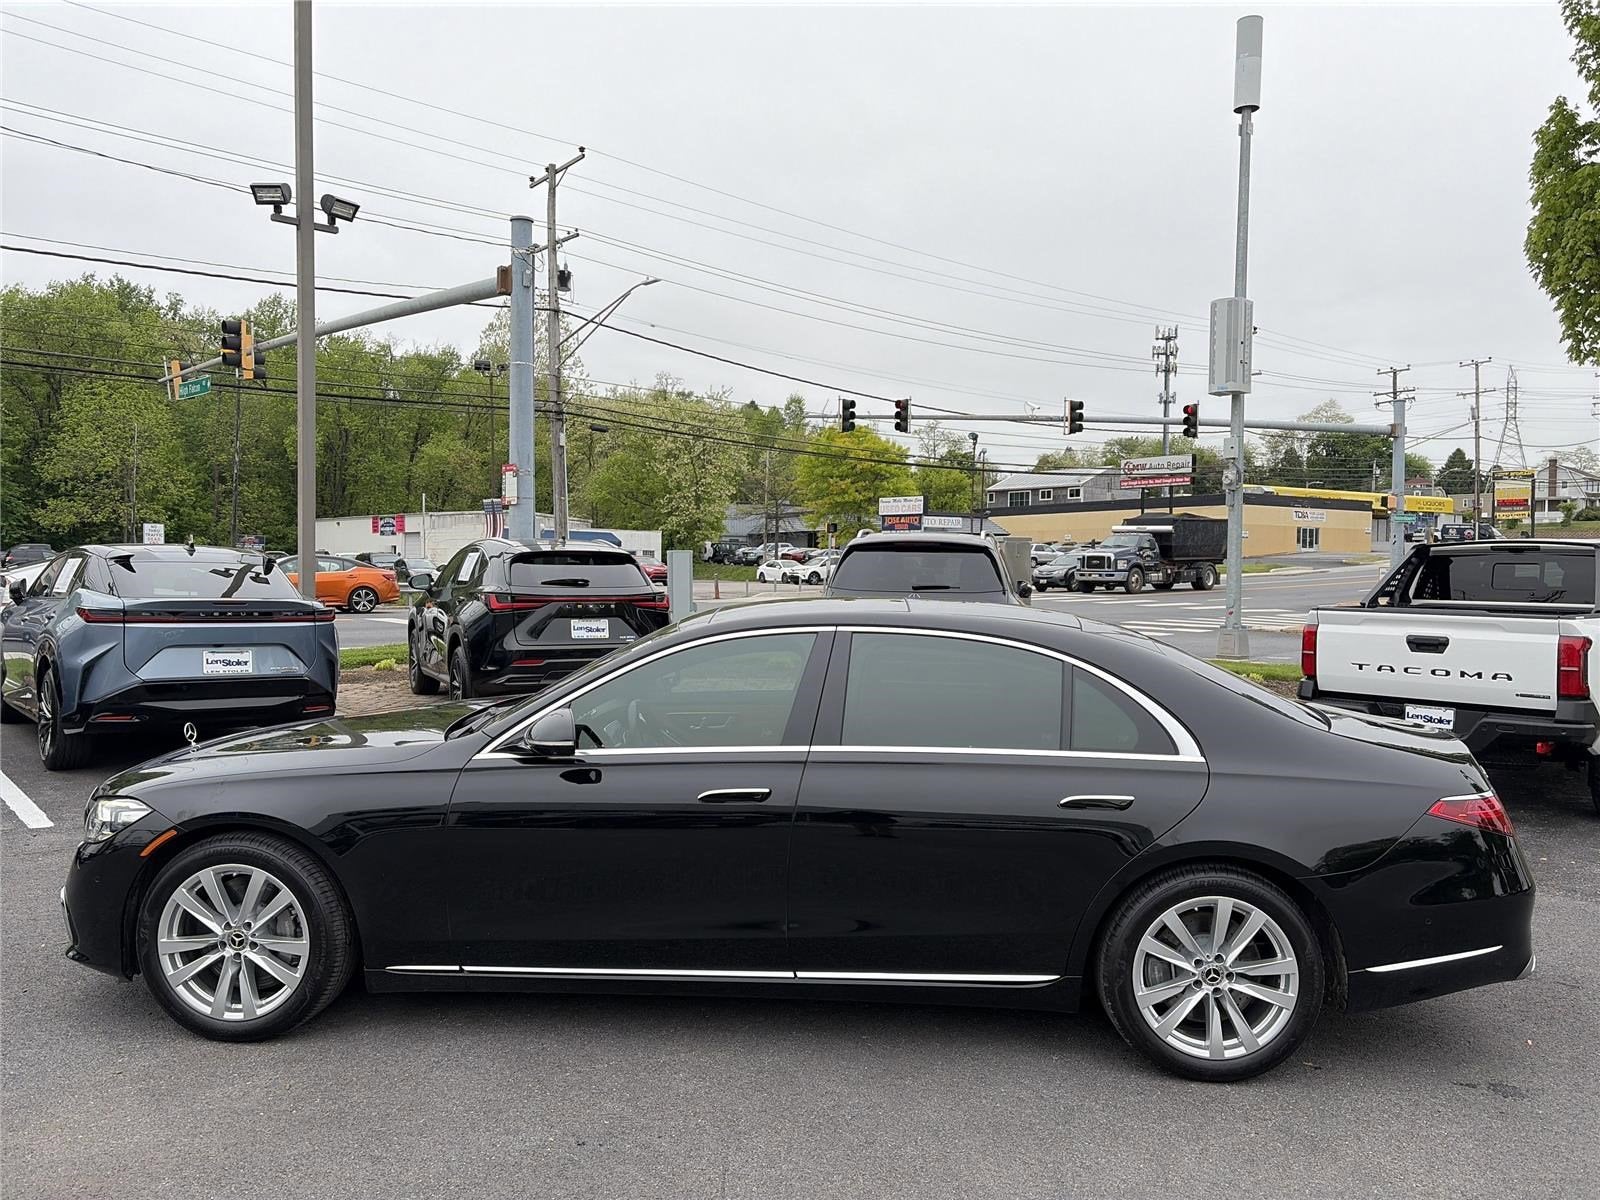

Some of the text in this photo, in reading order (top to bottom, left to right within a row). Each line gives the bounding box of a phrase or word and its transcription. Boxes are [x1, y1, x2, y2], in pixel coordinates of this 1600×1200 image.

[1149, 462, 1165, 470] Auto
[1166, 460, 1190, 470] Repair
[880, 503, 922, 514] USED CARS
[1422, 500, 1446, 508] LIQUORS
[938, 517, 962, 528] REPAIR
[1350, 662, 1514, 682] TACOMA
